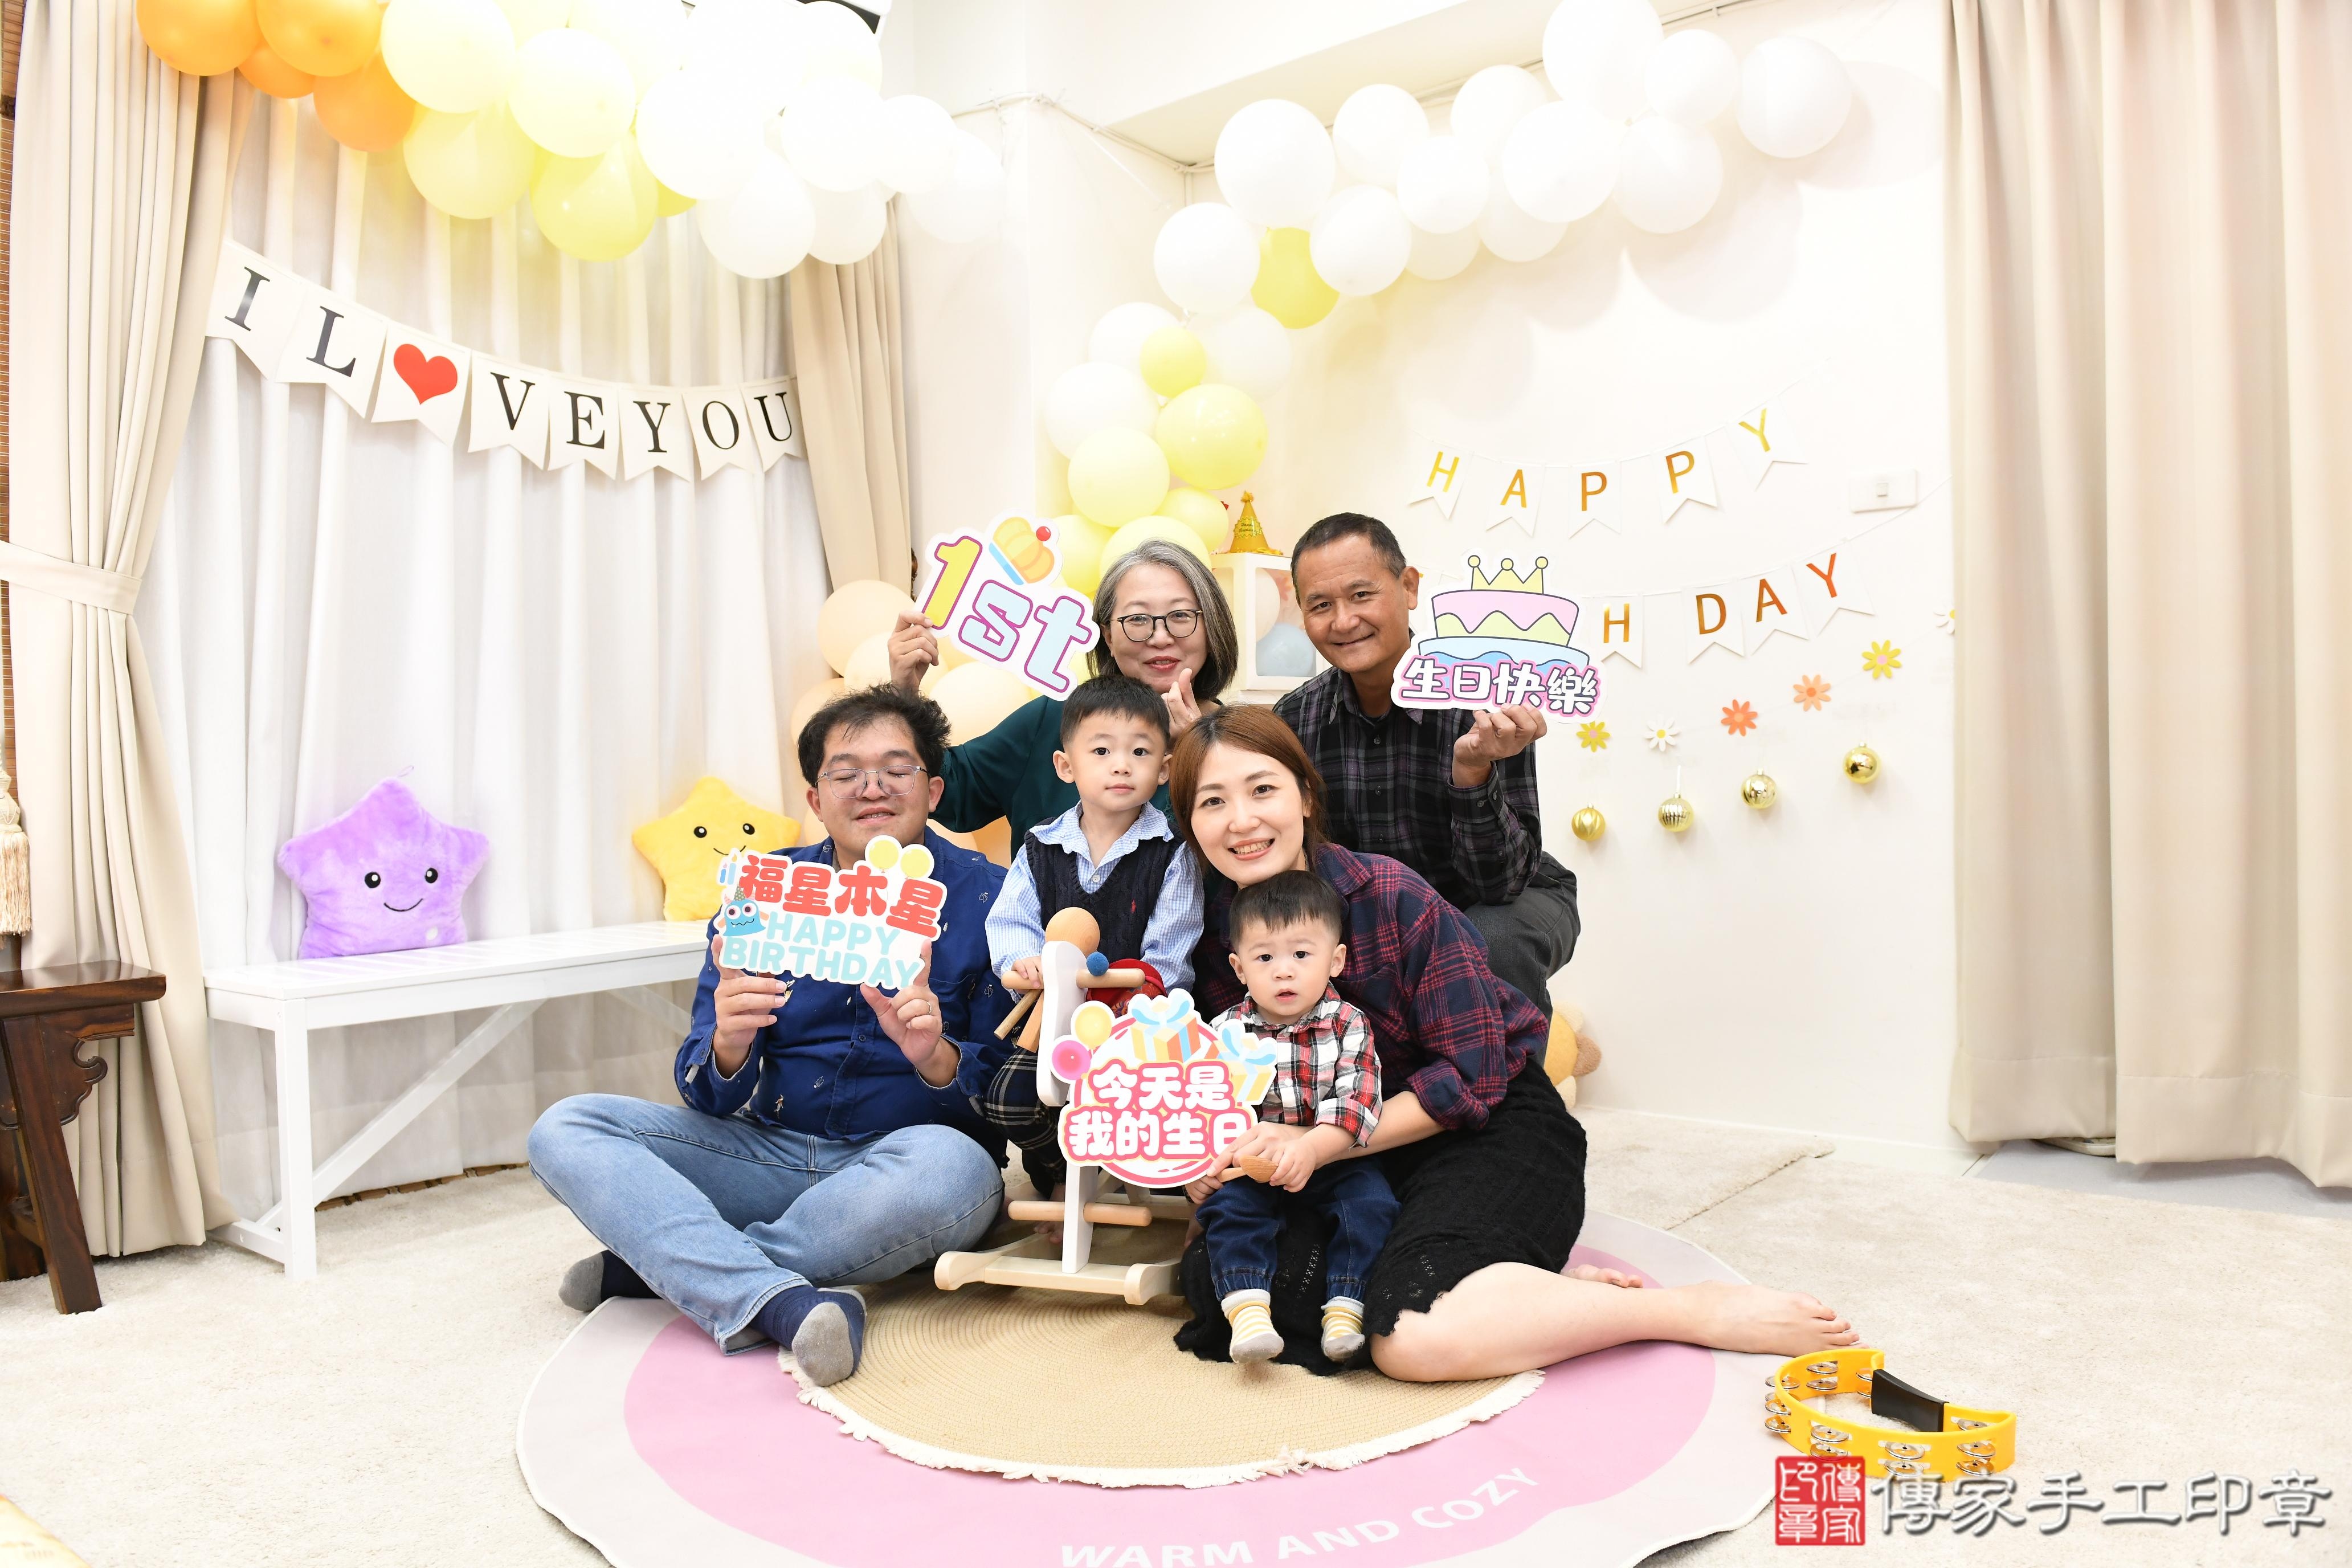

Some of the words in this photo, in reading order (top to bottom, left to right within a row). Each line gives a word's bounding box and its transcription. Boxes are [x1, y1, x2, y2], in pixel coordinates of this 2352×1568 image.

[224, 266, 270, 332] I
[1426, 408, 1770, 511] HAPPY
[921, 535, 1092, 693] 1st
[1696, 553, 1838, 635] DAY
[1401, 656, 1597, 715] 生日快樂
[740, 855, 944, 938] 福星本星
[722, 936, 921, 989] BIRTHDAY
[766, 911, 900, 956] HAPPY
[1092, 1063, 1231, 1110] 今天是
[1068, 1110, 1249, 1157] 我的生日
[1061, 1541, 1255, 1568] WARM
[1278, 1520, 1400, 1559] AND
[1411, 1467, 1540, 1529] COZY
